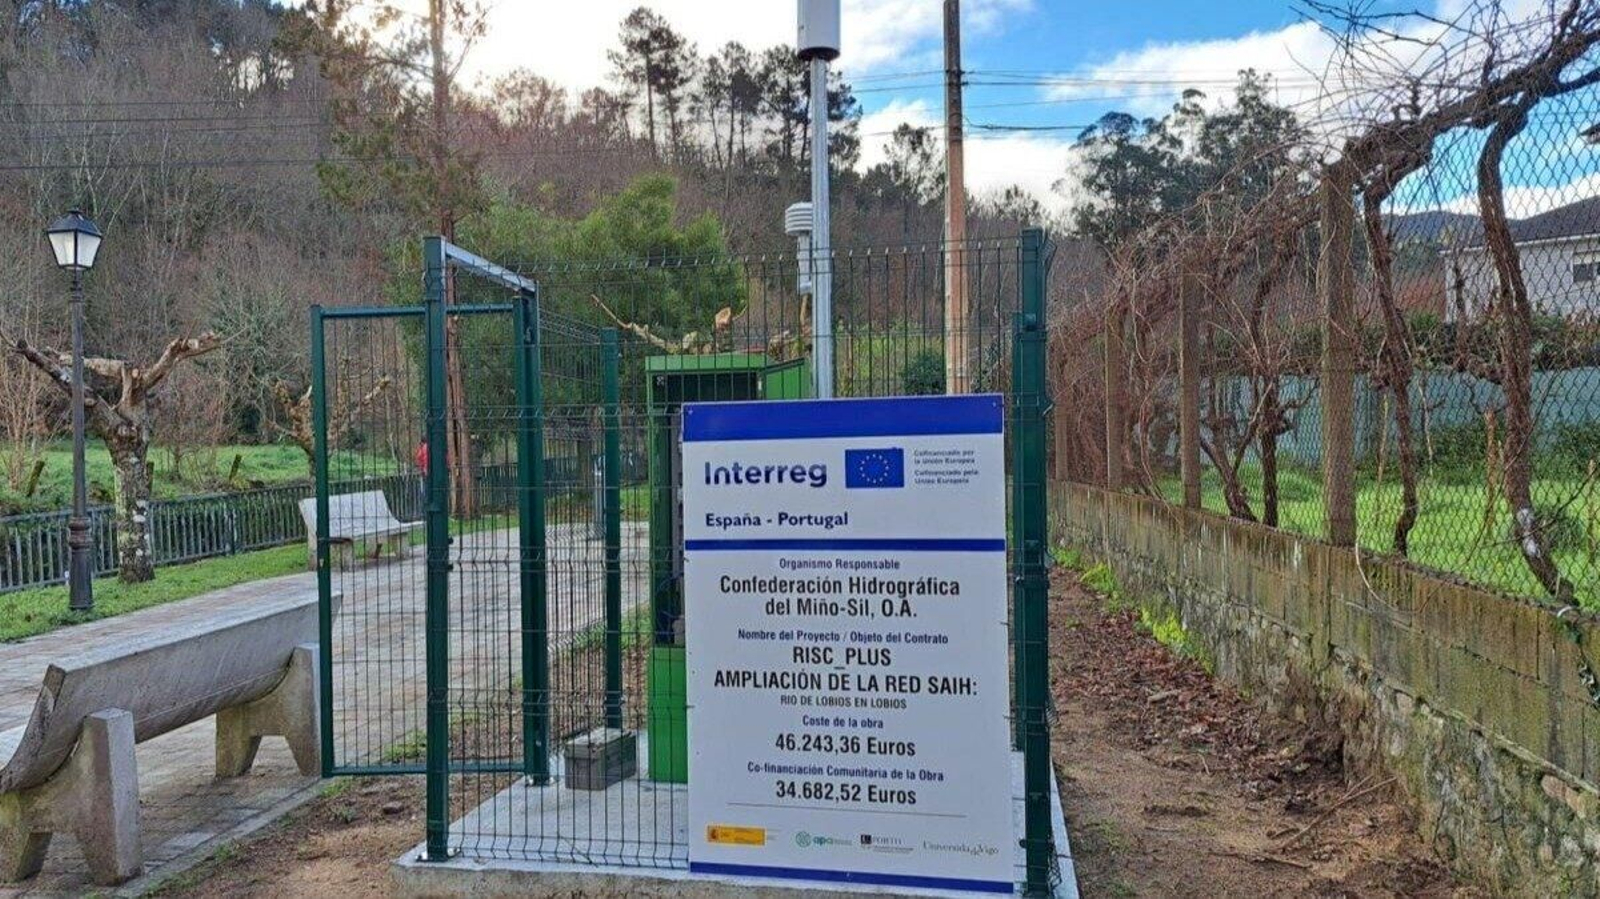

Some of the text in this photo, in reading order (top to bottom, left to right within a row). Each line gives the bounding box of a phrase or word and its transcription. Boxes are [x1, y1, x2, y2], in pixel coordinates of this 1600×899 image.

[704, 461, 828, 488] Interreg
[705, 513, 762, 530] España
[777, 511, 849, 530] Portugal
[779, 558, 900, 571] Organismo Responsable
[720, 575, 960, 599] Confederación Hidrográfica
[765, 598, 917, 620] del Miño-Sil, O.A.
[738, 629, 776, 641] Nombre
[779, 630, 794, 642] del
[797, 630, 840, 644] Proyecto
[850, 632, 883, 645] Objeto
[886, 632, 901, 644] del
[904, 633, 949, 645] Contrato
[792, 647, 892, 670] RISC_PLUS
[714, 669, 978, 696] AMPLIACIÓN DE LA RED SAIH:
[801, 695, 813, 707] DE
[815, 696, 851, 708] LOBIOS
[854, 697, 868, 709] EN
[871, 698, 907, 709] LOBIOS
[802, 715, 884, 729] Coste de la obra
[775, 733, 916, 756] 46.243,36 Euros
[747, 761, 944, 782] Co-financiación Comunitaria de la Obra
[776, 780, 917, 805] 34.682,52 Euros
